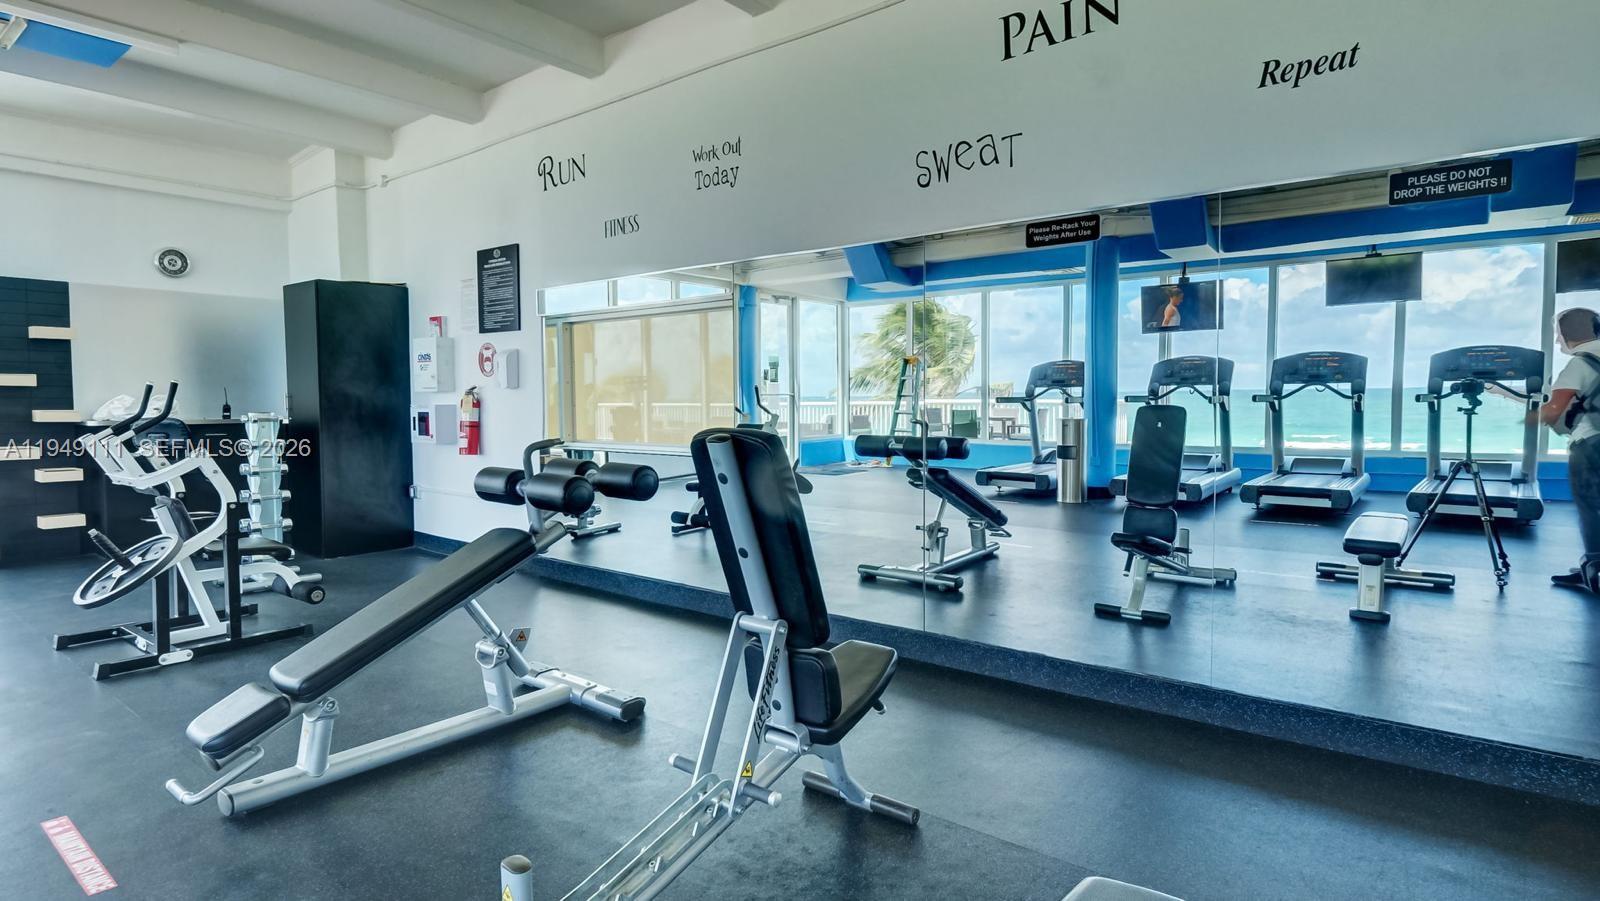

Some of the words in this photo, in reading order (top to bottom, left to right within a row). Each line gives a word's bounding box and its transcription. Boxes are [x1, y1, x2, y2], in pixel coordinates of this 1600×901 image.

[999, 0, 1120, 61] PAIN
[1257, 42, 1361, 88] Repeat
[692, 145, 720, 162] Work
[722, 136, 741, 156] Out
[538, 154, 587, 192] RUN
[695, 166, 739, 190] Today
[1408, 172, 1447, 186] PLEASE
[1450, 170, 1466, 181] DO
[1468, 166, 1492, 179] NOT
[1394, 187, 1423, 199] DROP
[1425, 184, 1446, 195] THE
[1448, 178, 1498, 193] WEIGHTS
[1500, 176, 1507, 186] !!
[604, 214, 640, 239] FITNESS
[1029, 226, 1050, 235] Please
[1051, 222, 1079, 231] Re-Rack
[1080, 219, 1097, 228] Your
[1033, 233, 1059, 242] Weights
[1060, 231, 1077, 239] After
